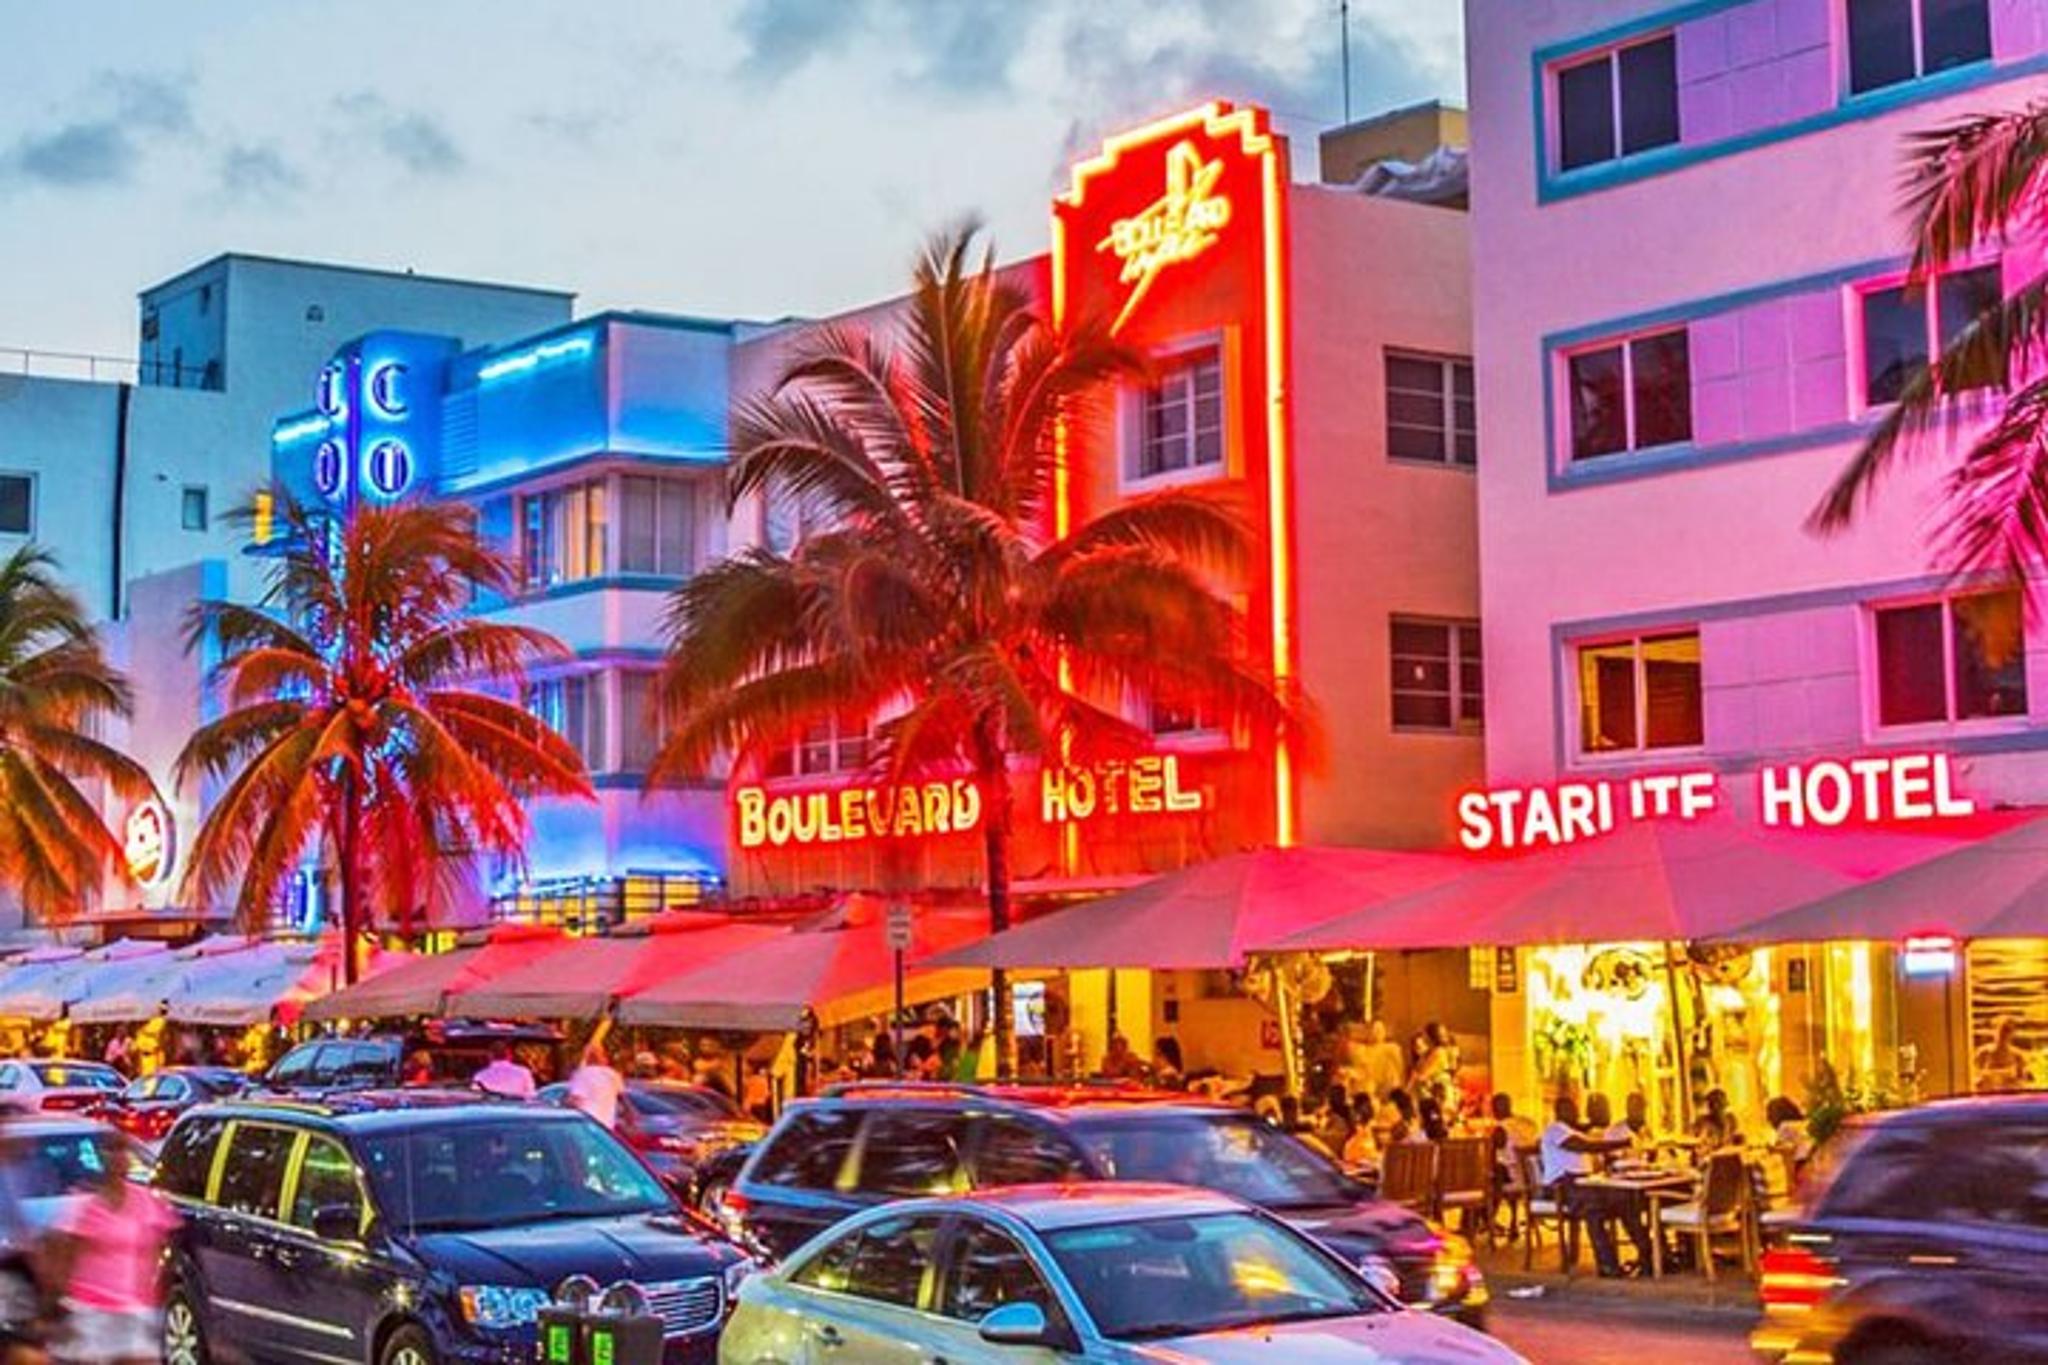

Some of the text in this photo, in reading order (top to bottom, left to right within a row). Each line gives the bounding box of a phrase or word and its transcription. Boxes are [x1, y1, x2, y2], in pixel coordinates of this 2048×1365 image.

[737, 754, 1202, 847] BOULEVARD HOTEL
[1762, 753, 1974, 827] HOTEL
